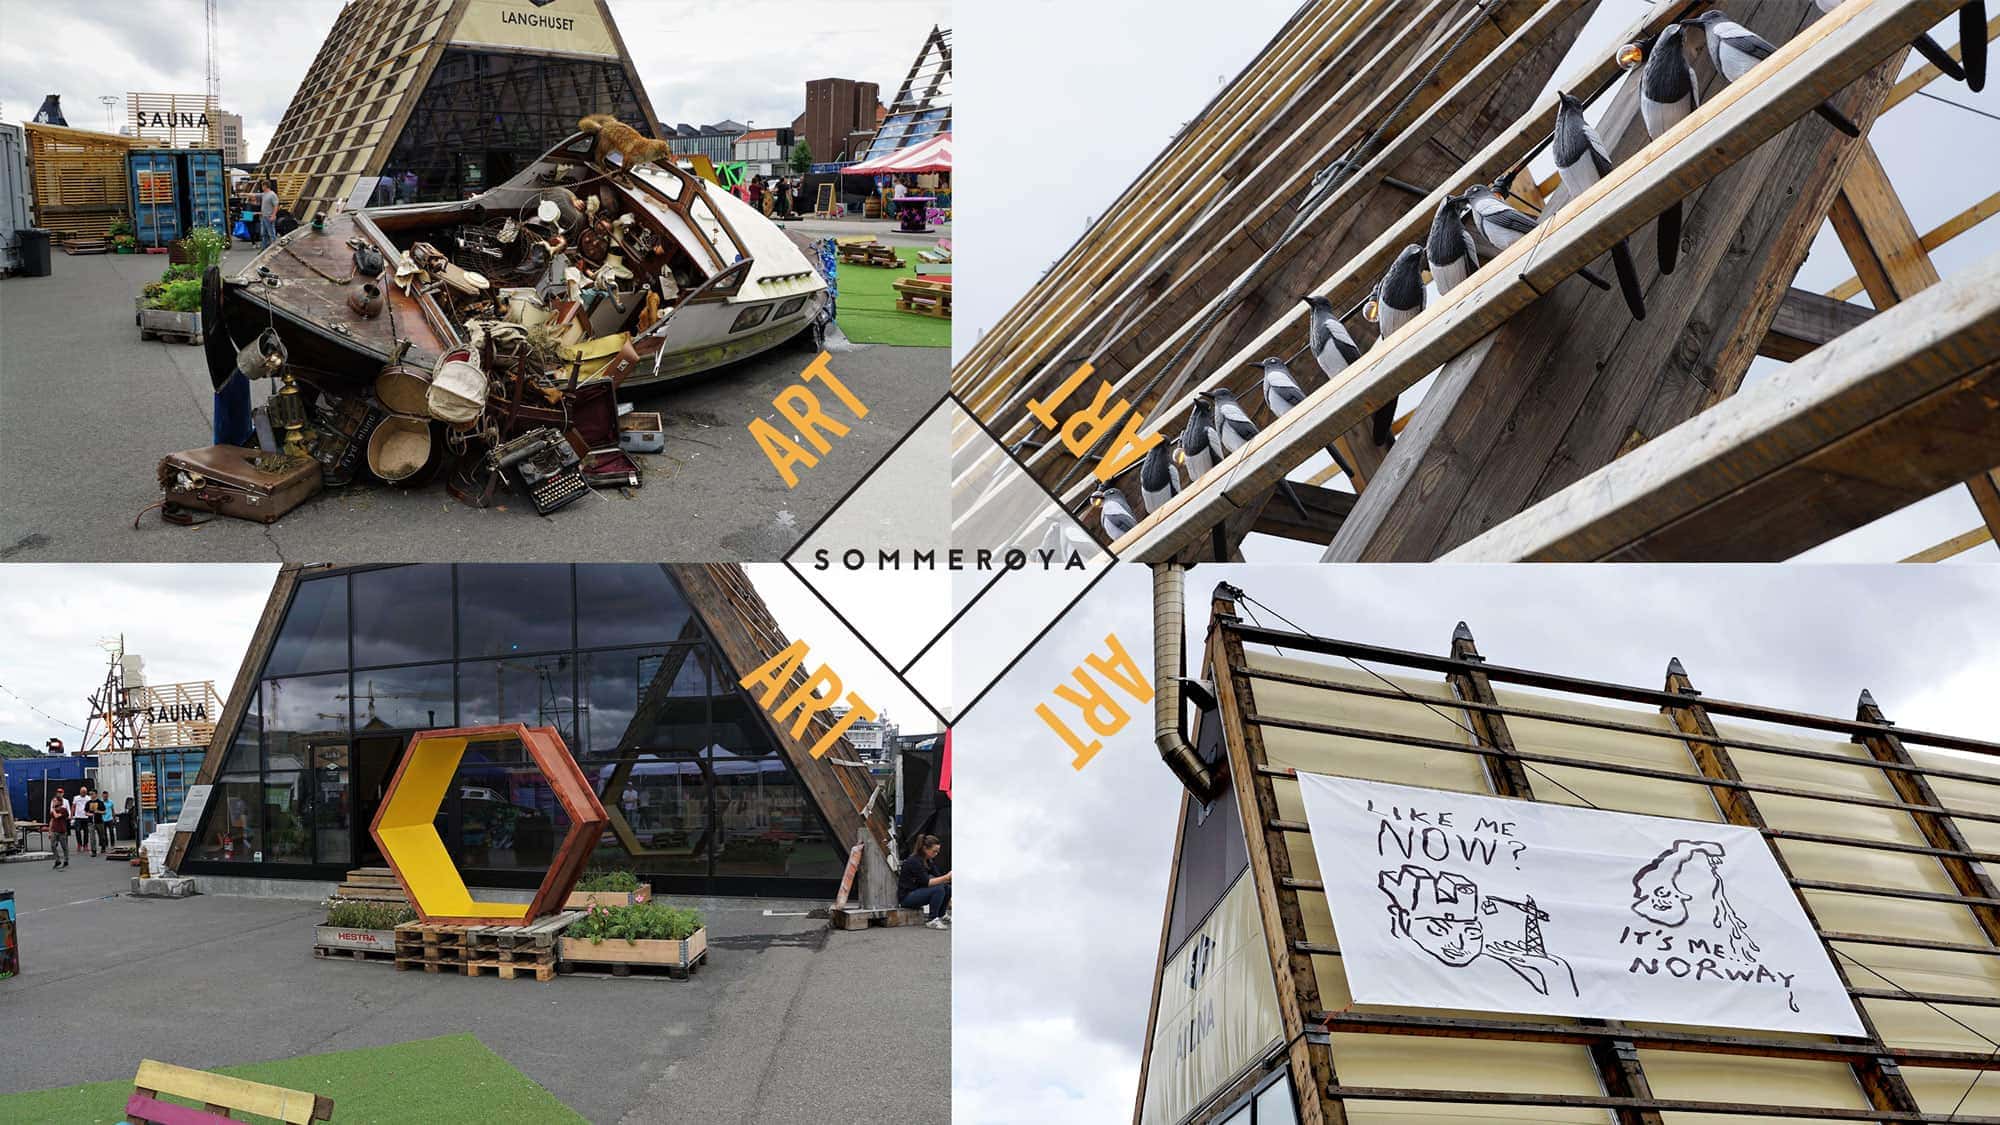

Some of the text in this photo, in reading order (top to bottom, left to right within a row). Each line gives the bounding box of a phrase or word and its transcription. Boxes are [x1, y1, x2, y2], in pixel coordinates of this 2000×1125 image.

[502, 11, 574, 31] LANGHUSET
[137, 111, 211, 128] SAUNA
[148, 703, 207, 723] SAUNA
[1367, 799, 1517, 837] LIKE ME
[1377, 818, 1528, 871] NOW?
[337, 931, 377, 943] HESTRA
[1619, 926, 1674, 951] IT'S
[1628, 956, 1796, 988] NORWAY
